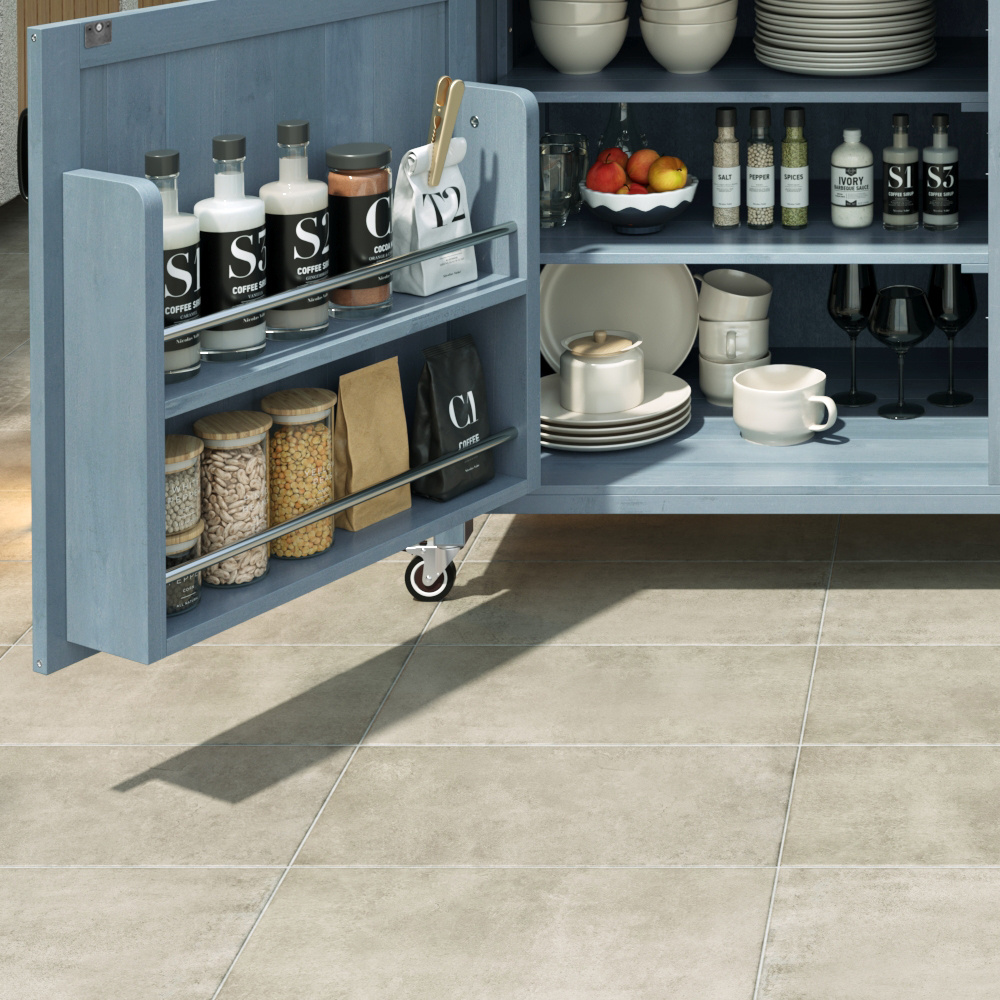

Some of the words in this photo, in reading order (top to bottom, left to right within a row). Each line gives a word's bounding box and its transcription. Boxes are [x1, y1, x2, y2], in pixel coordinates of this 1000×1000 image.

[838, 176, 864, 186] IVORY
[887, 165, 914, 189] S1
[926, 165, 955, 189] S3
[422, 186, 466, 229] T2
[164, 246, 201, 299] S1
[297, 263, 322, 276] COFFEE
[232, 282, 258, 295] COFFEE
[164, 302, 192, 316] COFFEE
[448, 390, 479, 429] C1
